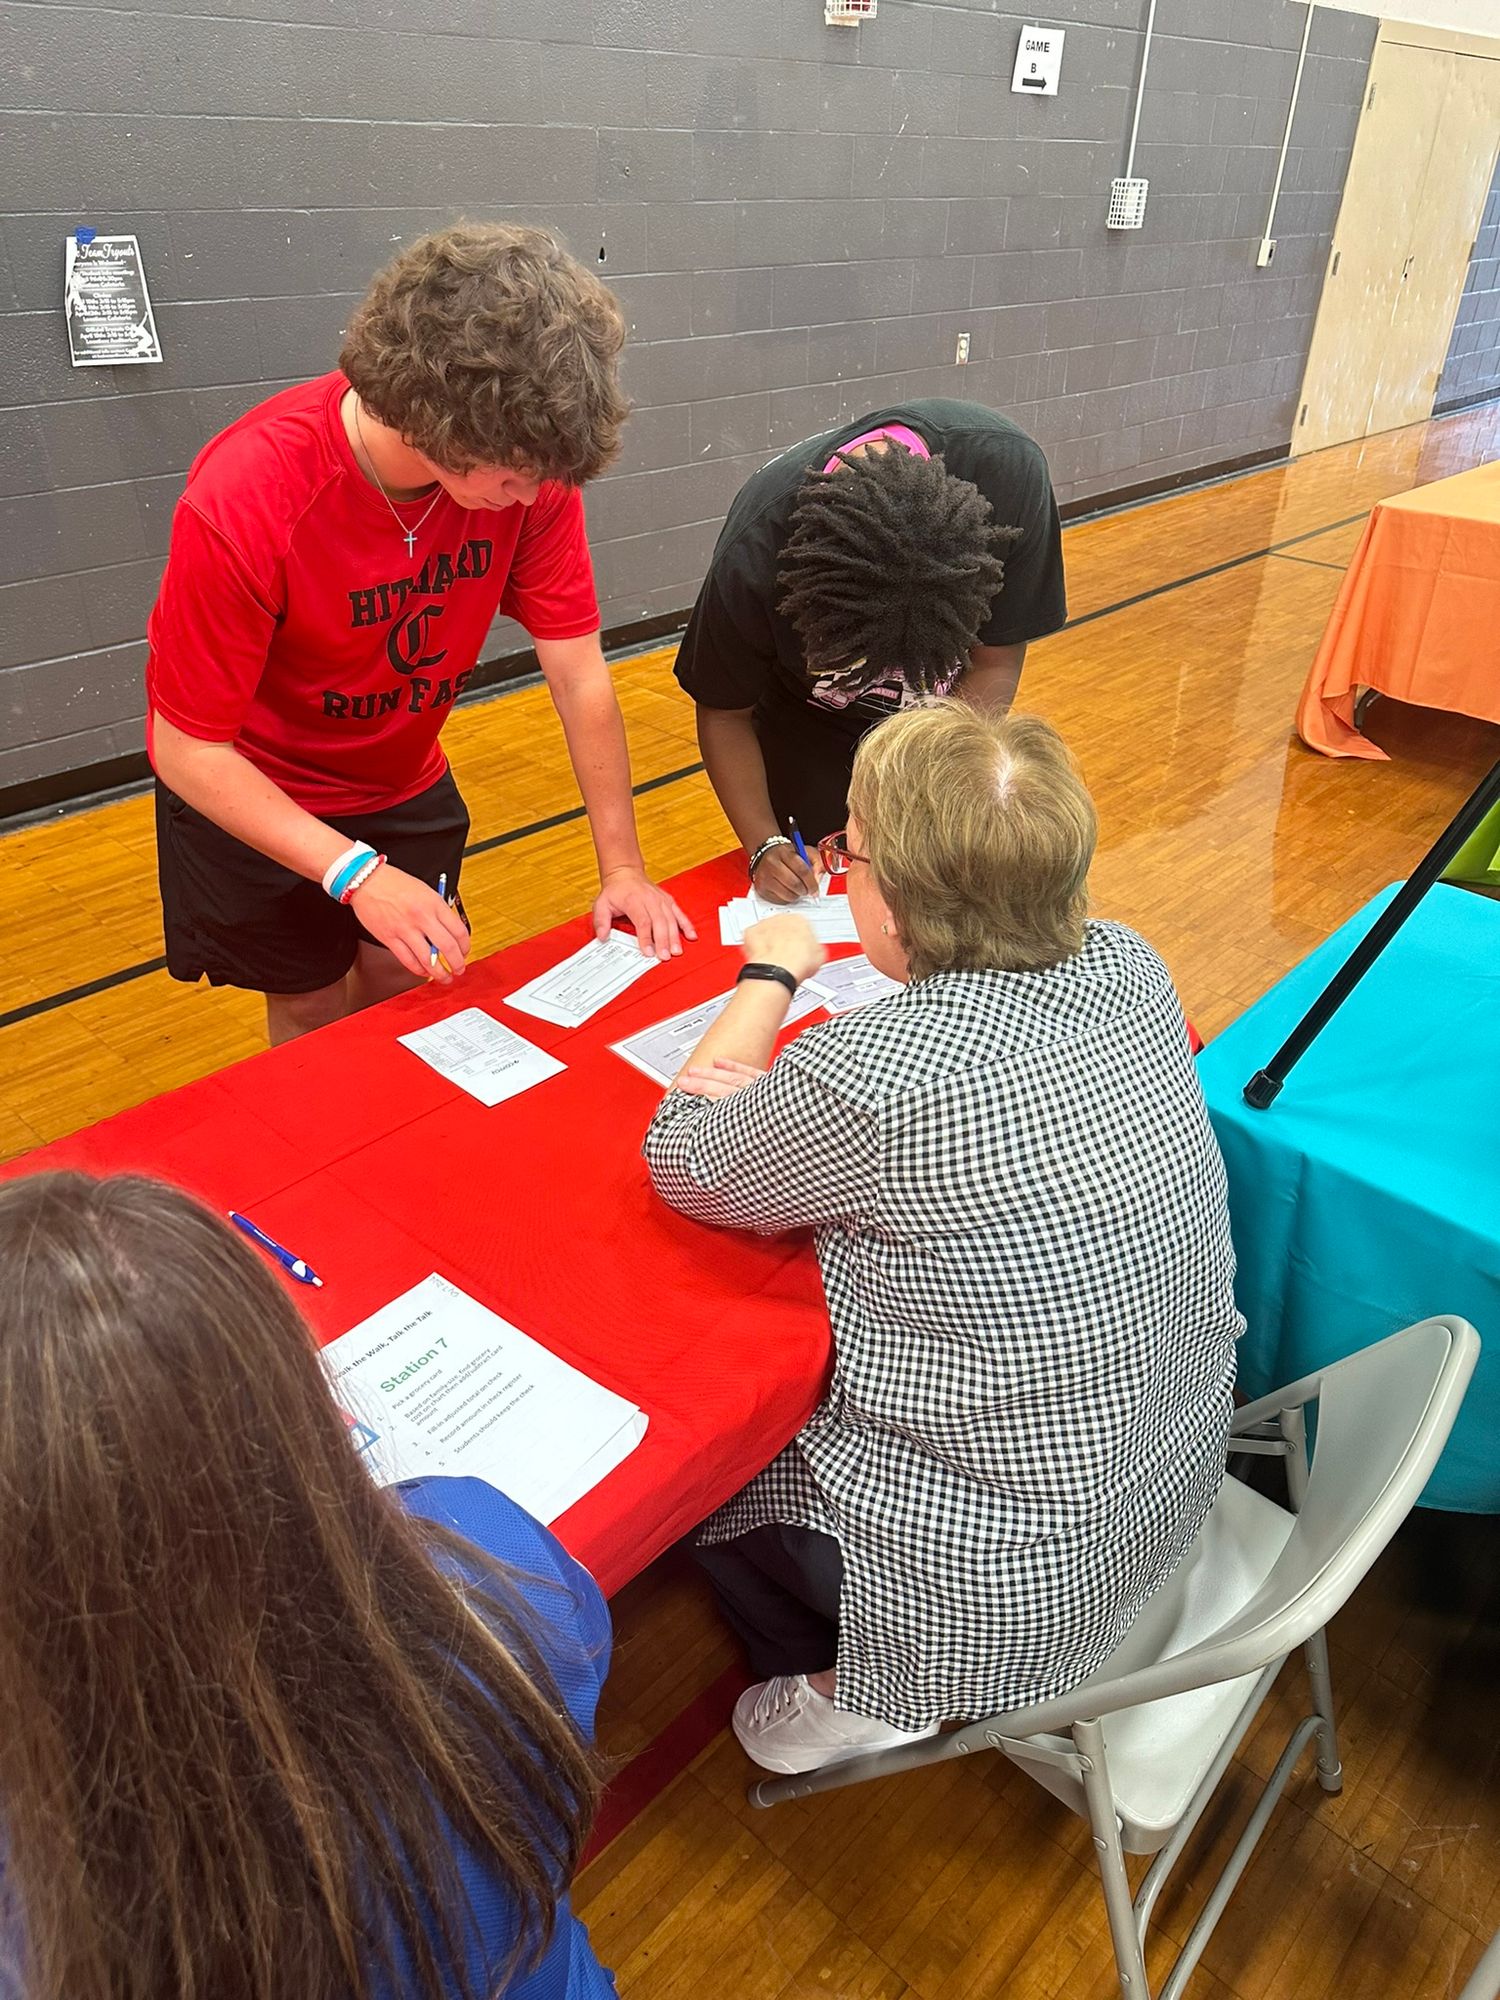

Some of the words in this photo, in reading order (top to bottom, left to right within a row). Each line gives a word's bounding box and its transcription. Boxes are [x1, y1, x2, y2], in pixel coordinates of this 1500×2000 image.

[1026, 40, 1050, 53] GAME
[1030, 62, 1037, 73] B
[348, 577, 413, 628] HIT
[322, 687, 402, 720] RUN
[408, 668, 474, 714] FAS
[352, 1356, 366, 1367] the
[387, 1330, 404, 1341] Talk
[403, 1321, 417, 1331] the
[416, 1311, 432, 1322] Talk
[380, 1349, 439, 1392] Station
[435, 1337, 447, 1348] 7
[392, 1399, 405, 1409] Pick
[409, 1379, 431, 1397] grocery
[429, 1369, 443, 1380] card
[404, 1403, 423, 1418] Based
[430, 1393, 446, 1406] chart
[444, 1383, 459, 1394] then
[439, 1425, 461, 1444] Record
[460, 1408, 482, 1427] amount
[487, 1391, 503, 1404] check
[502, 1373, 522, 1391] register
[443, 1401, 468, 1422] adjusted
[466, 1390, 480, 1402] total
[487, 1372, 503, 1385] check
[453, 1432, 480, 1454] Students
[478, 1416, 498, 1433] should
[496, 1405, 511, 1417] keep
[509, 1397, 520, 1406] the
[519, 1384, 534, 1398] check
